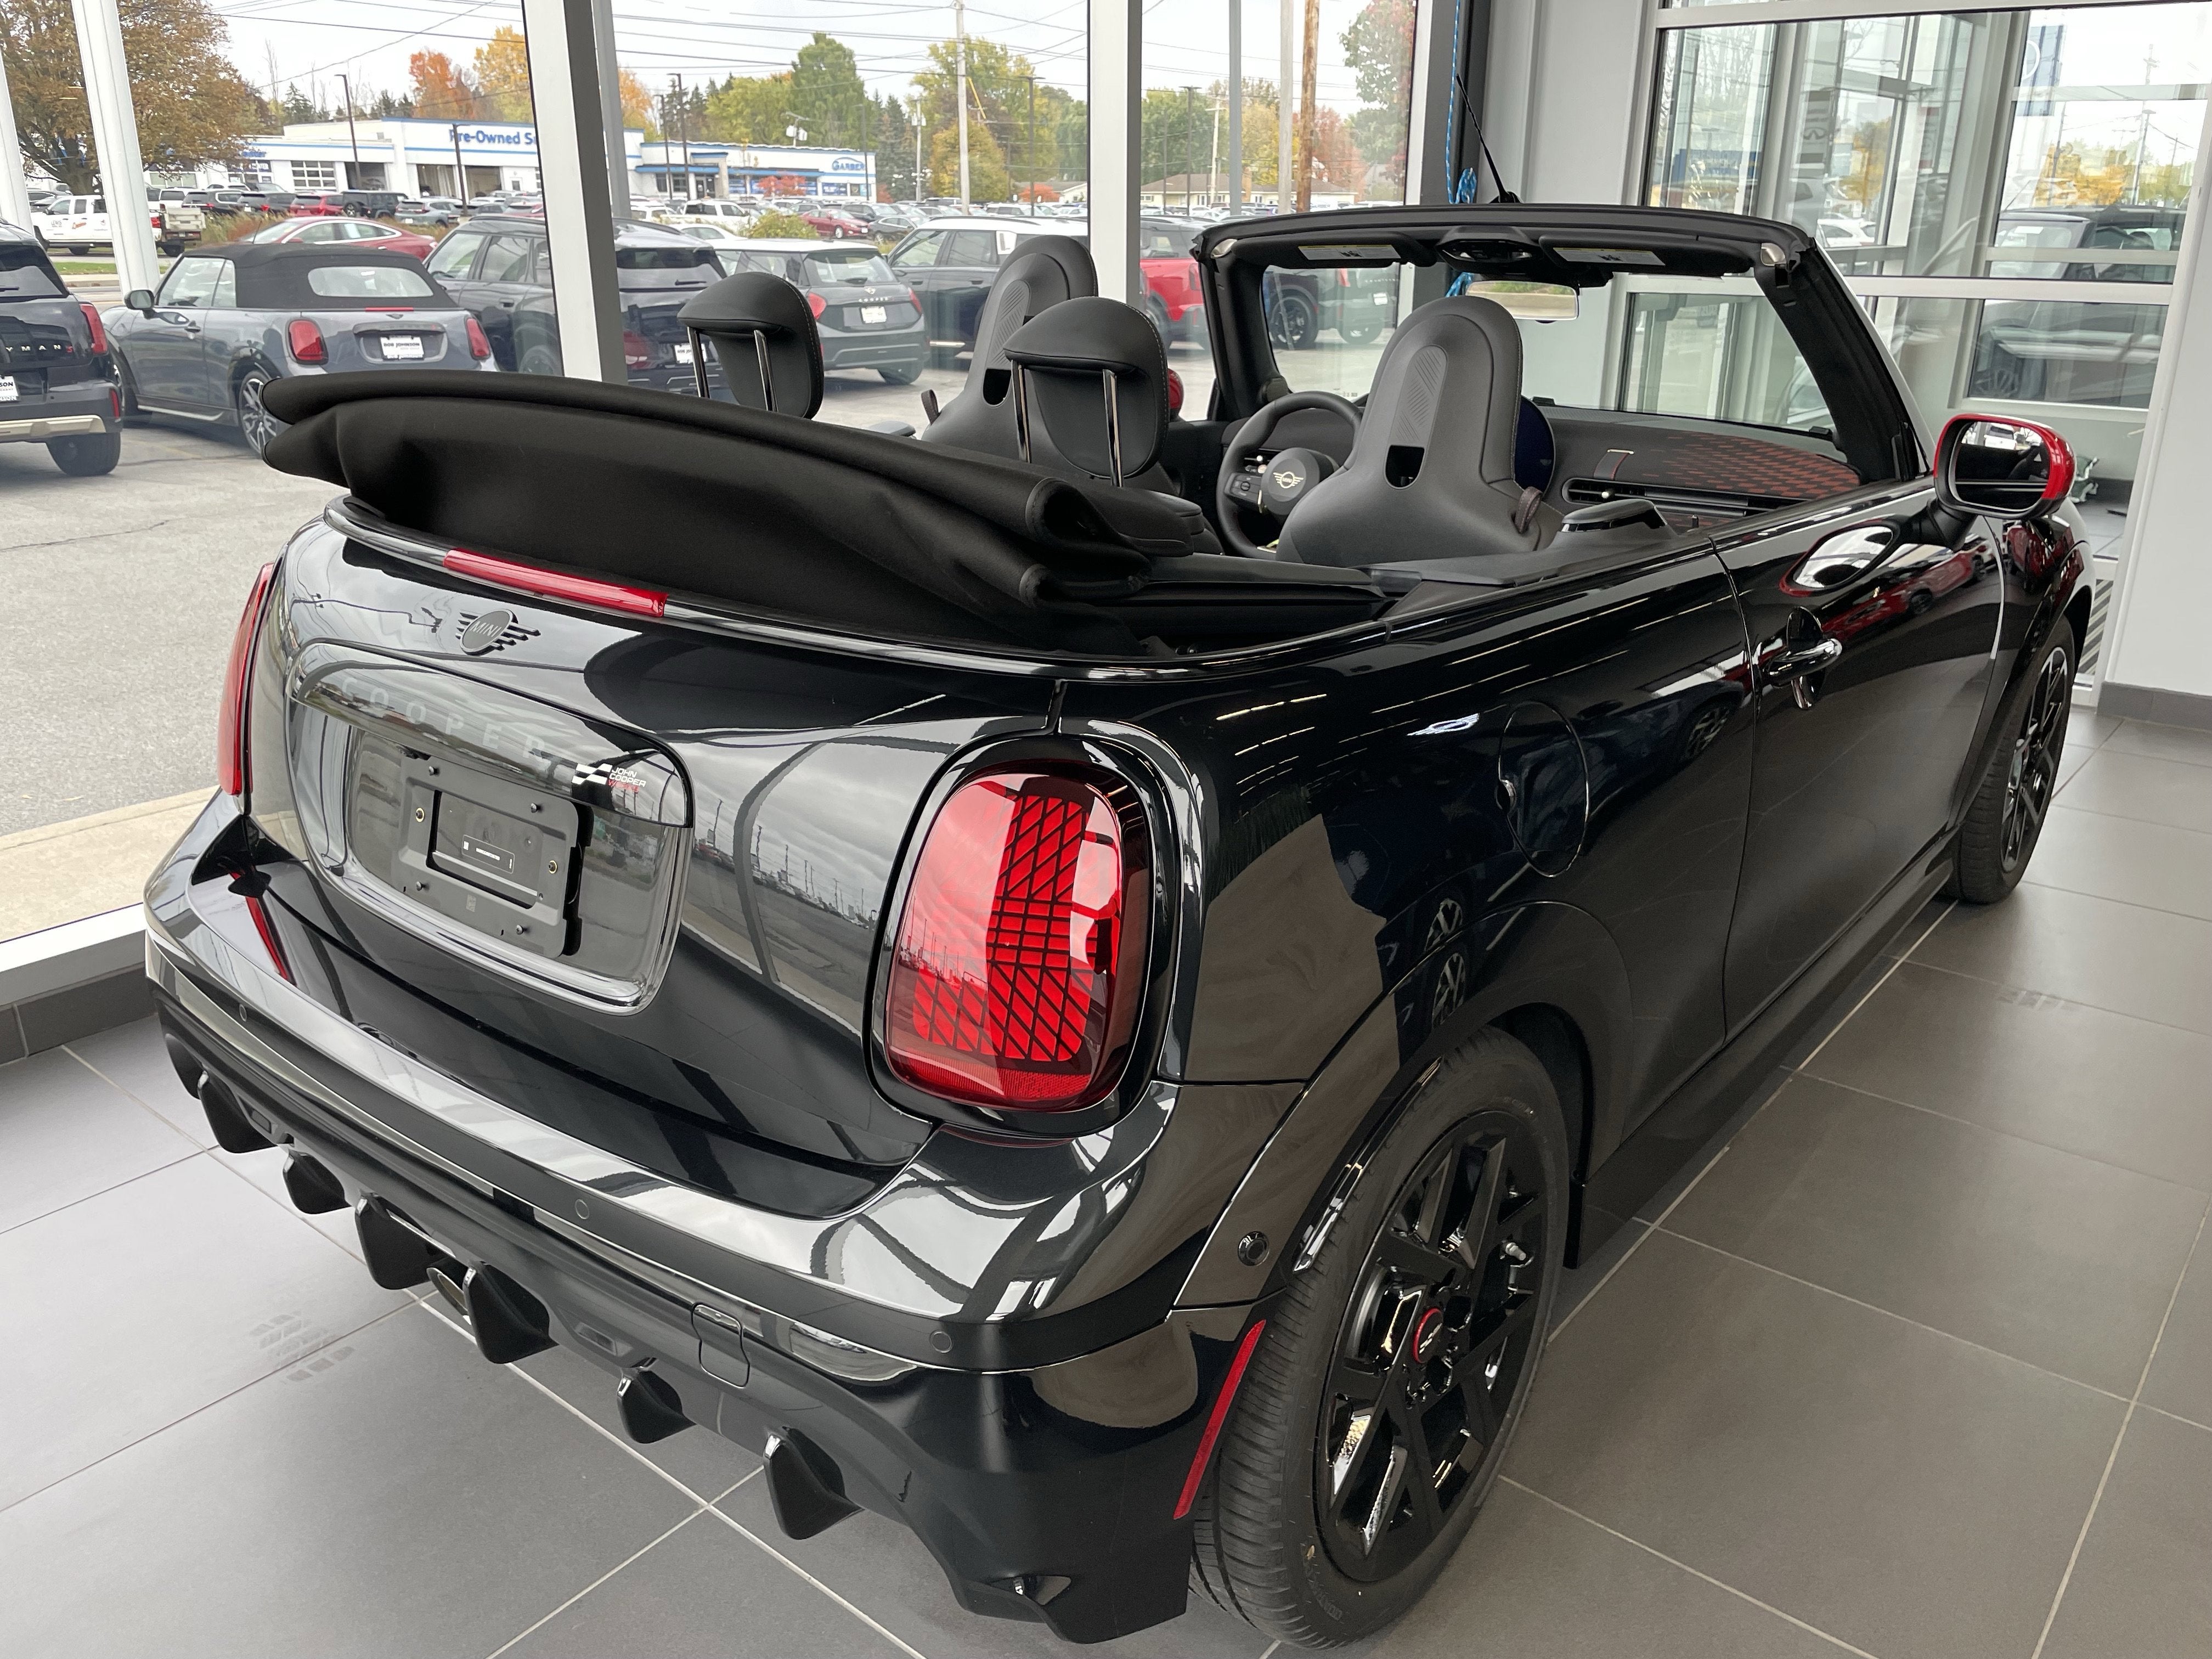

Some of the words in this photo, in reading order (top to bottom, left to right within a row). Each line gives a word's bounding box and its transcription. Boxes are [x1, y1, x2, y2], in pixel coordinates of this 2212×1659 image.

[449, 129, 520, 144] Pre-Owned
[525, 133, 537, 144] S
[470, 620, 502, 637] MINI
[341, 677, 550, 763] COOPER
[609, 773, 647, 787] COOPER
[611, 767, 637, 778] JOHN
